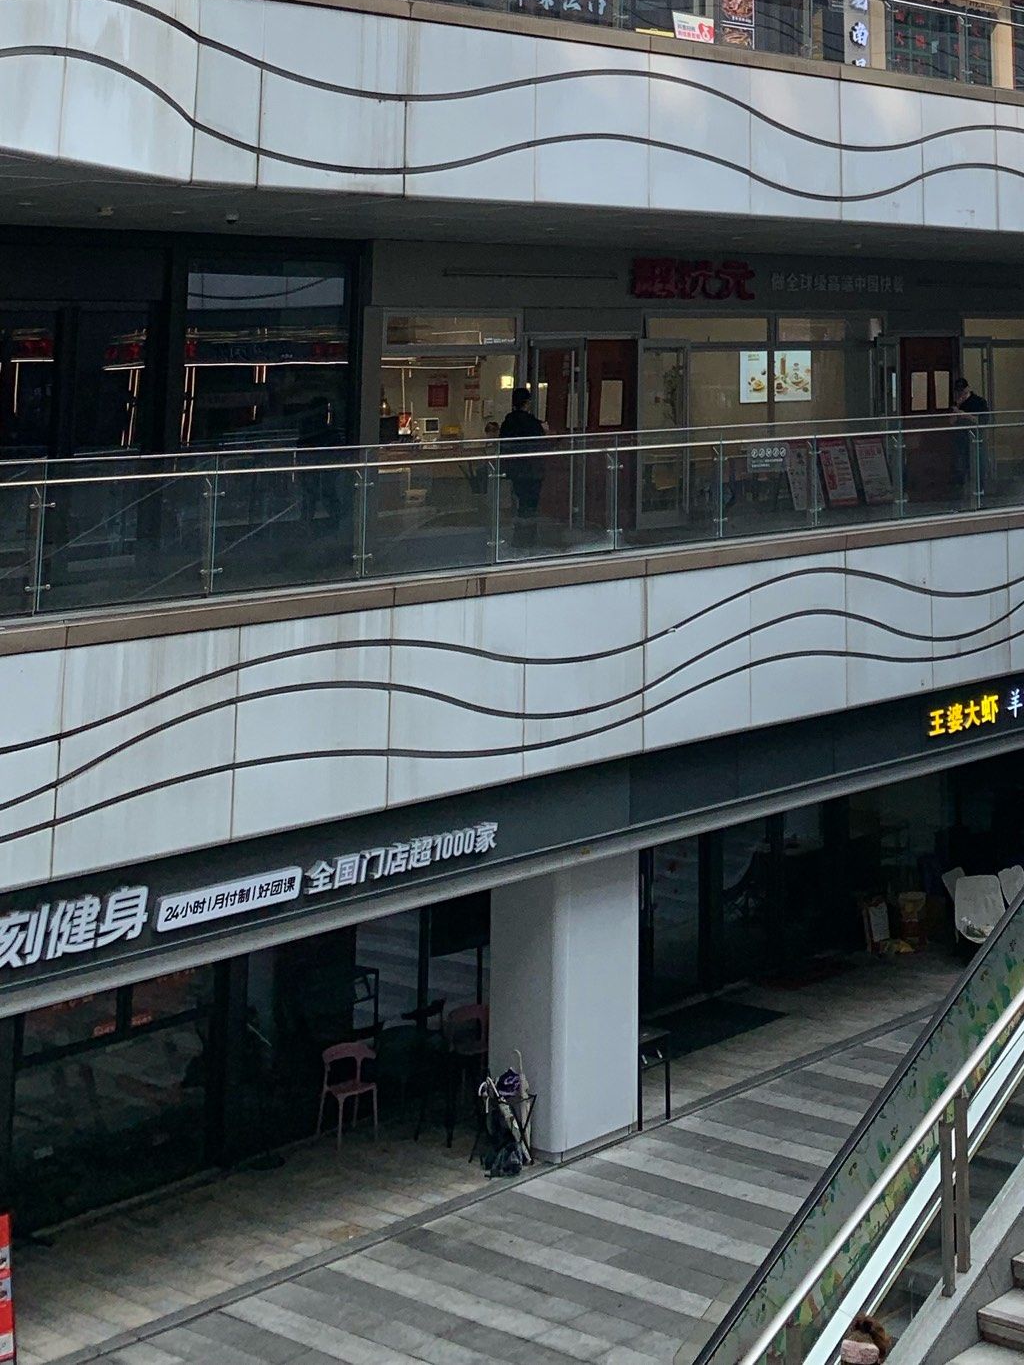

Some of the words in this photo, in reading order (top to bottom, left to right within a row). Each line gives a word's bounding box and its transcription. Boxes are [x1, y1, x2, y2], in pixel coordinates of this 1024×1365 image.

[928, 692, 999, 737] 王婆大虾
[304, 822, 498, 895] 全国门店超1000家
[0, 885, 149, 970] 刻健身
